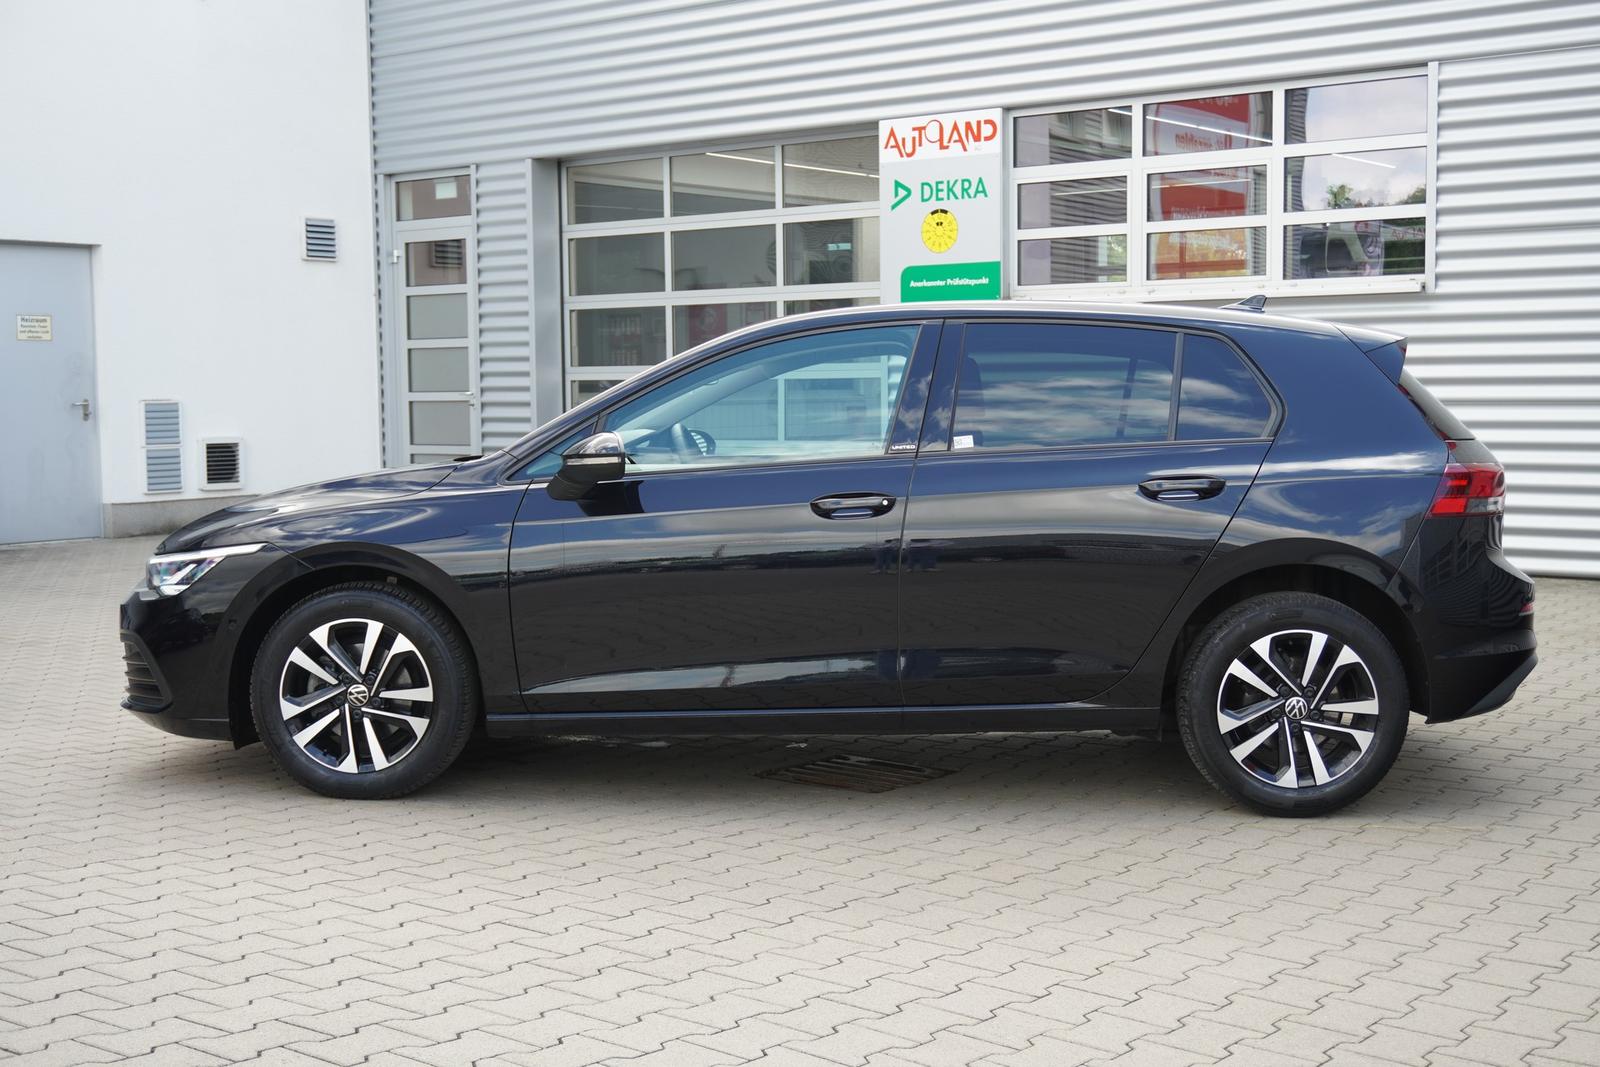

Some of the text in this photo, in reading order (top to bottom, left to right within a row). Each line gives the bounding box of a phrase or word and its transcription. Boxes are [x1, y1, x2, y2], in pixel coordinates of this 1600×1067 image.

[884, 119, 997, 158] AUTOLAND
[920, 177, 988, 203] DEKRA
[910, 279, 946, 287] Anerkannter
